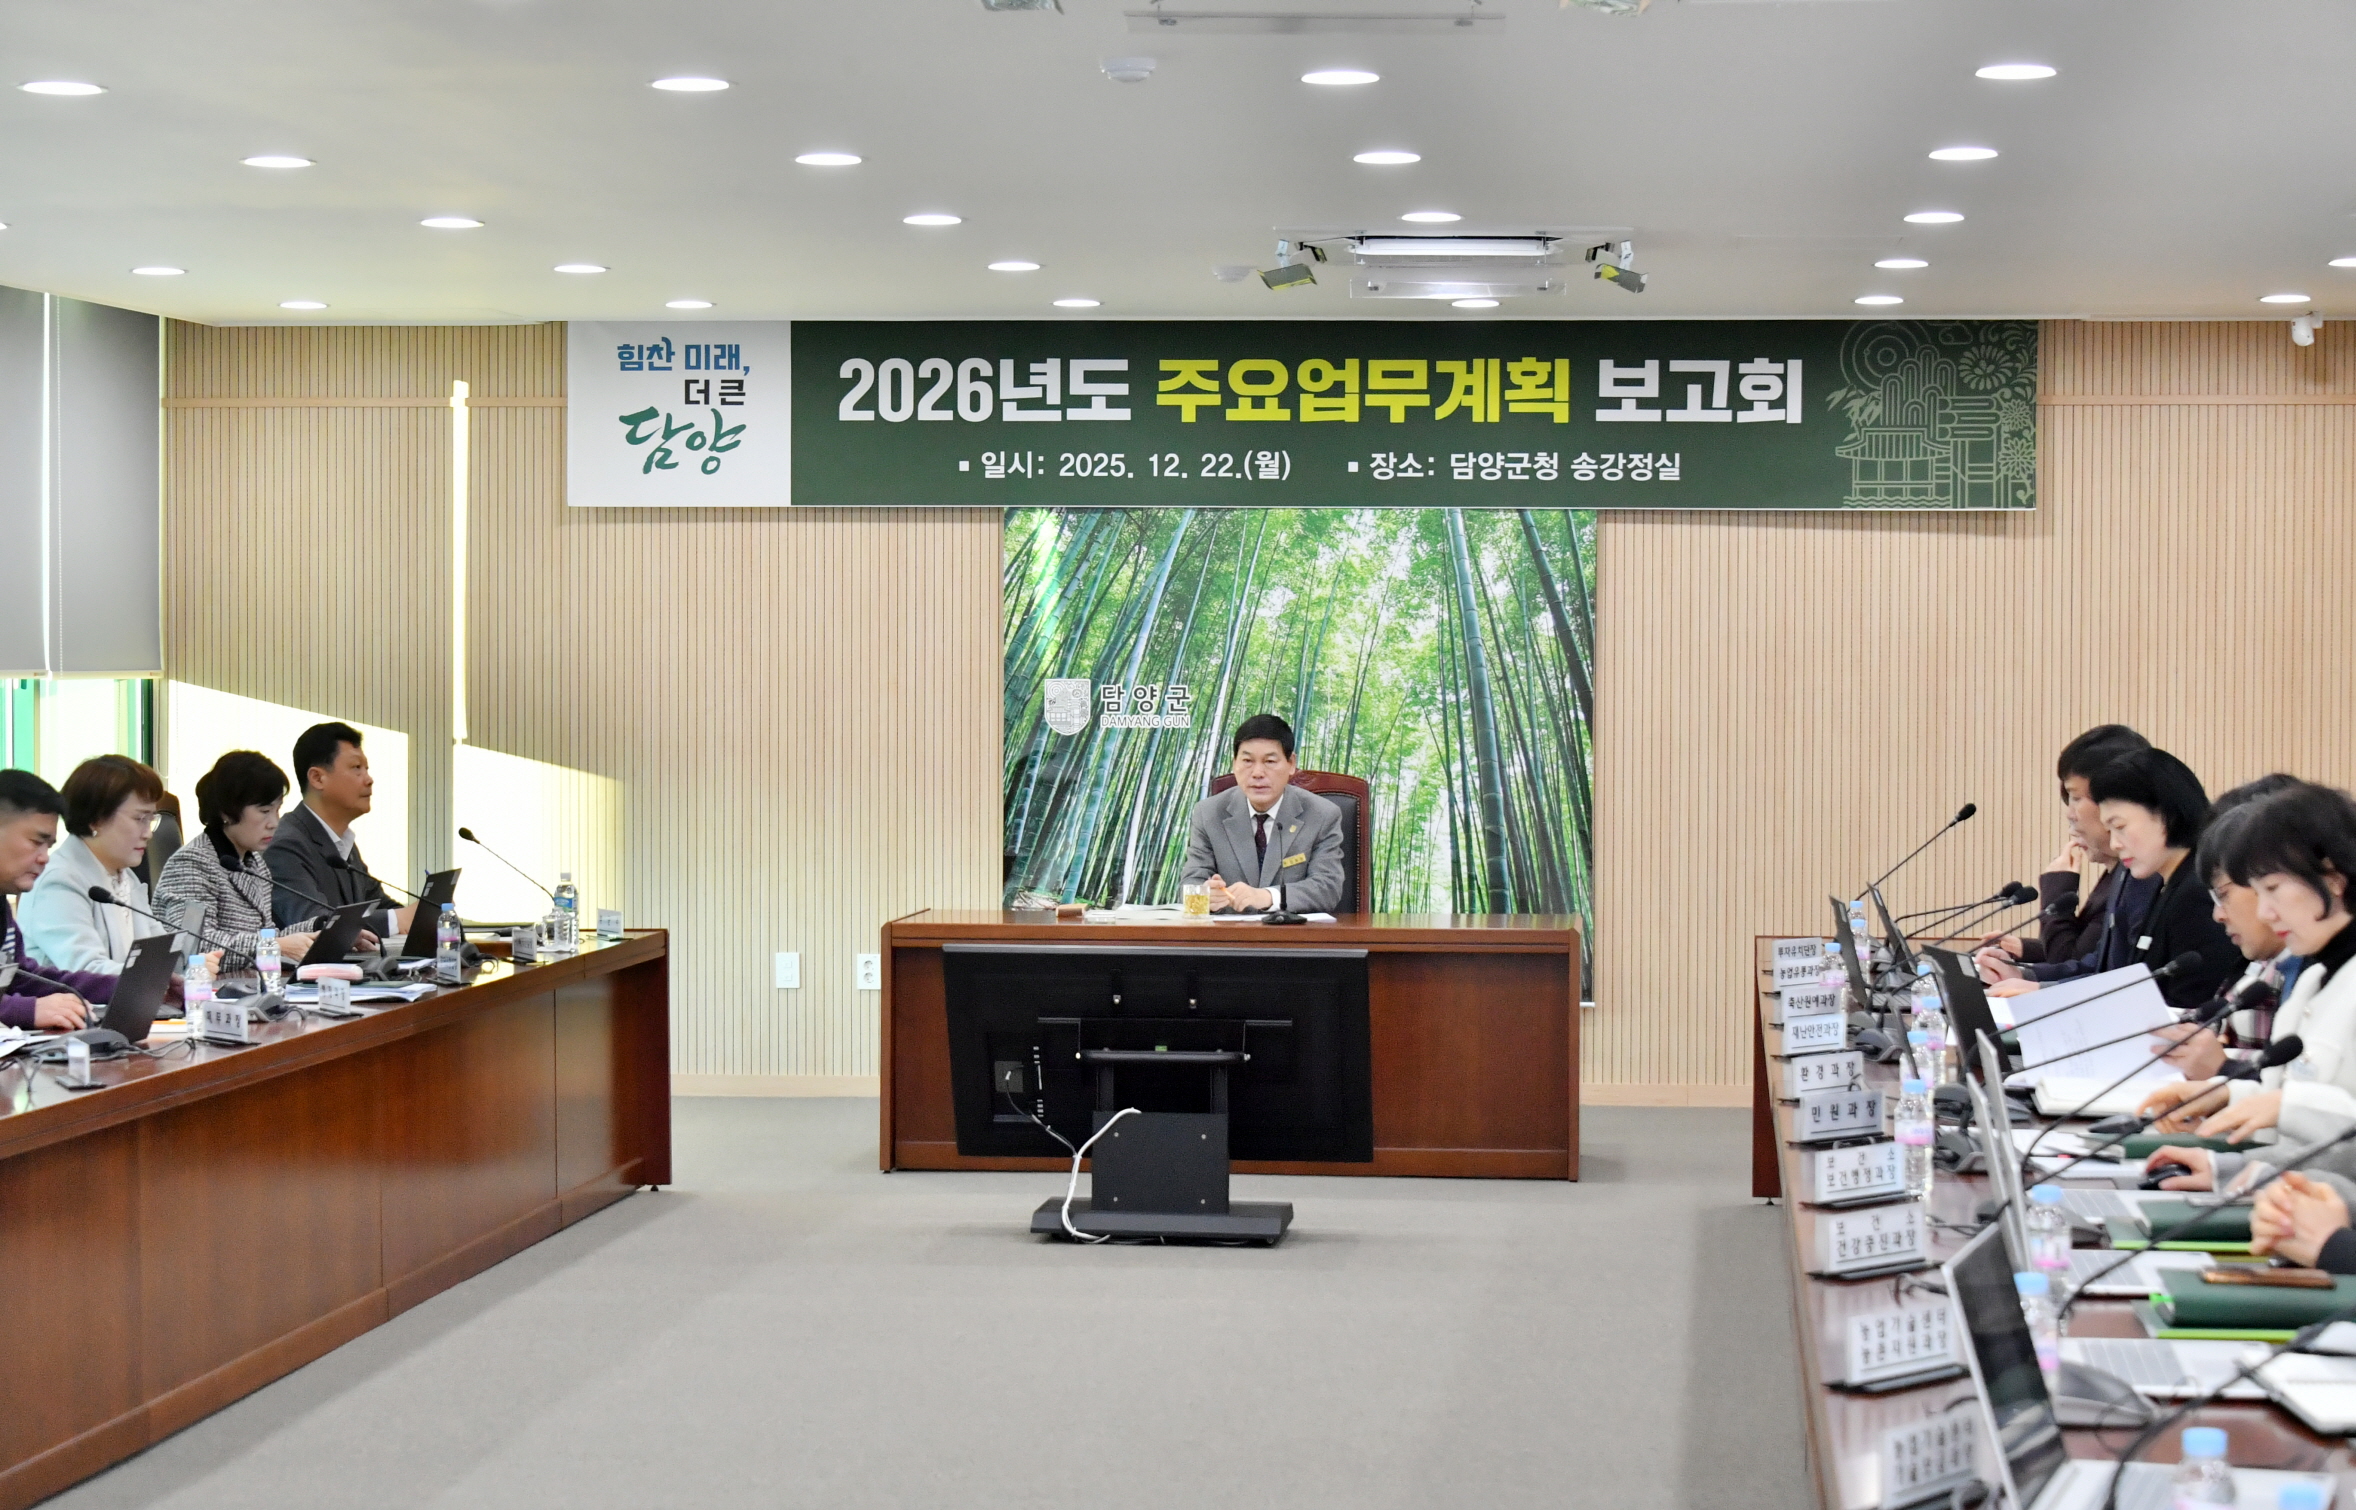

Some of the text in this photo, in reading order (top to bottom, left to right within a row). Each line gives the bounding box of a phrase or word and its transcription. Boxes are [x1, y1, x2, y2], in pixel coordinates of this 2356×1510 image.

[617, 336, 751, 377] 힘찬 미래,
[685, 379, 747, 406] 더 큰
[838, 357, 1803, 424] 2026년도 주요업무계획 보고회
[618, 405, 747, 475] 담양
[981, 449, 1291, 481] 일시: 2025. 12. 22.(월)
[1369, 451, 1681, 482] 장소: 담양군청 송강정실
[1101, 685, 1190, 713] 담양군
[1101, 714, 1190, 728] DAMYANG GUN
[1788, 993, 1836, 1010] 축산원예과장
[1791, 1021, 1840, 1040] 재난안전과장
